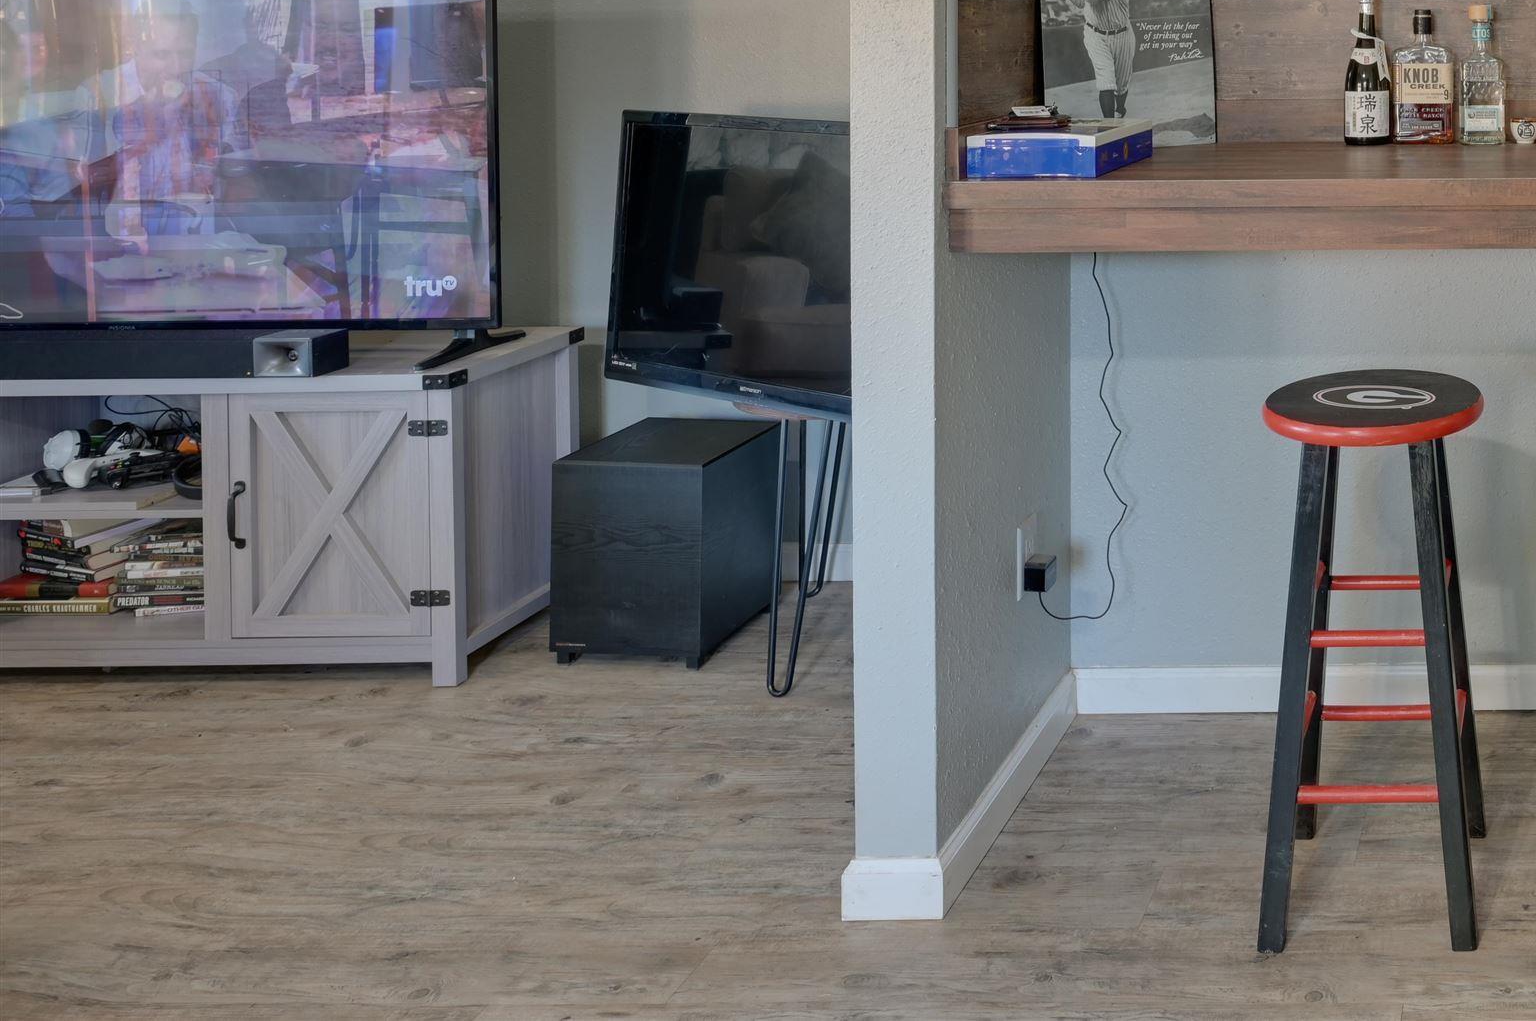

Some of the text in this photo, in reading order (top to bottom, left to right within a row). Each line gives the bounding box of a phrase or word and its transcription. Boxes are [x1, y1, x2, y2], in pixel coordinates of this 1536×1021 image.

[1163, 22, 1172, 31] let
[1173, 22, 1184, 31] the
[1184, 22, 1200, 32] fear
[1143, 31, 1152, 42] of
[1153, 31, 1180, 41] striking
[1139, 42, 1151, 51] get
[1152, 40, 1160, 49] in
[1160, 42, 1178, 51] your
[1403, 68, 1439, 83] KNOB
[117, 596, 150, 607] PREDATOR
